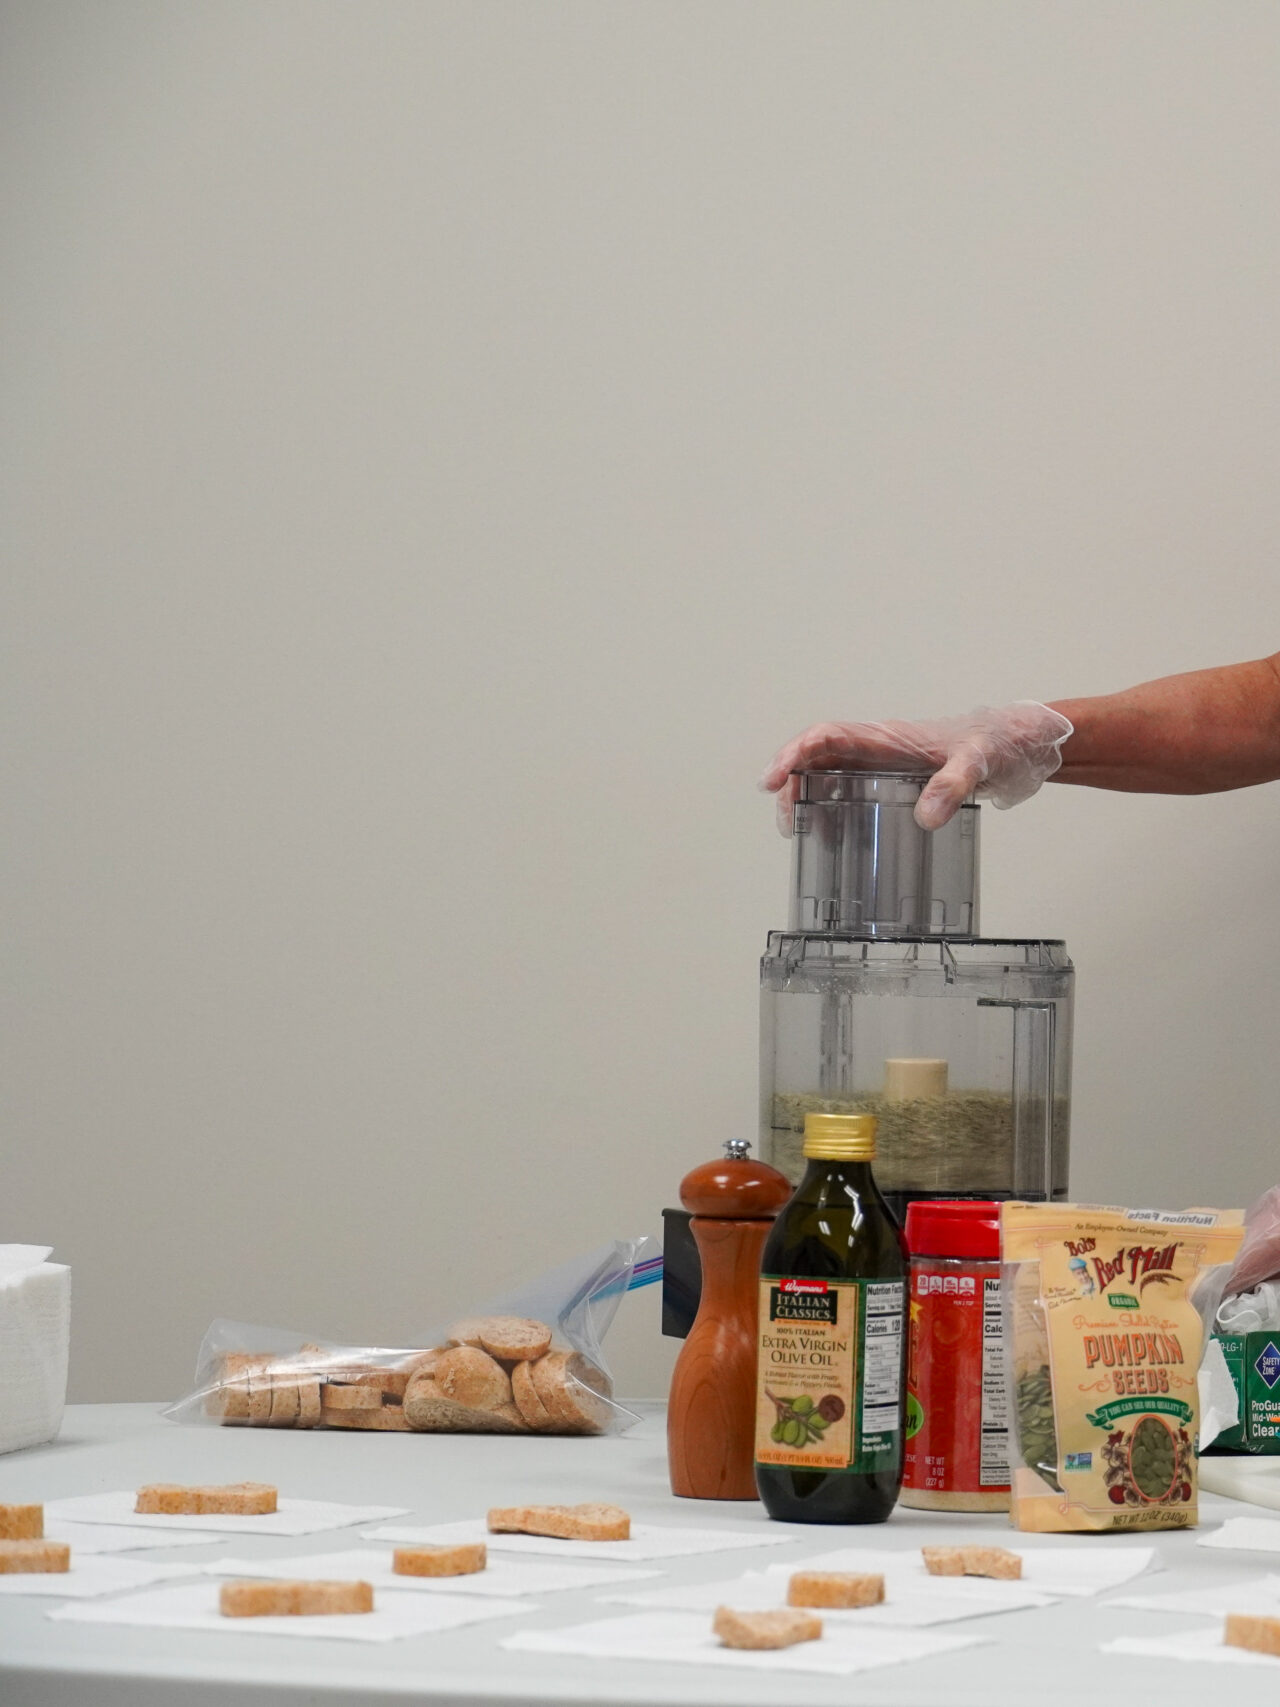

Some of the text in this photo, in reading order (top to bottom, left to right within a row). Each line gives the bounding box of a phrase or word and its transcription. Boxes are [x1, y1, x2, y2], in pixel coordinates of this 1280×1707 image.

[1139, 1226, 1169, 1237] Company
[1064, 1236, 1096, 1257] Bob's
[1091, 1242, 1178, 1295] Red Mill
[784, 1280, 824, 1296] Wegmans
[867, 1285, 891, 1296] Nutrition
[776, 1293, 830, 1307] ITALIAN
[776, 1305, 831, 1319] CLASSICS
[776, 1327, 793, 1335] 100%
[867, 1319, 901, 1333] Calories 120
[762, 1335, 848, 1352] EXTRA VIRGIN
[771, 1350, 832, 1366] OLIVE OIL
[1083, 1333, 1184, 1369] PUMPKIN
[1262, 1356, 1280, 1366] SAFETY
[1262, 1366, 1275, 1375] ZONE
[1112, 1368, 1170, 1395] SEEDS
[1108, 1405, 1121, 1416] YOU
[1121, 1402, 1133, 1411] CAN
[1133, 1401, 1144, 1409] SEE
[1156, 1401, 1180, 1412] QUALITY
[1252, 1423, 1279, 1437] Clear
[925, 1456, 944, 1466] NET WT
[937, 1467, 944, 1477] OZ
[1112, 1515, 1126, 1526] NET
[1161, 1511, 1188, 1524] (340g)
